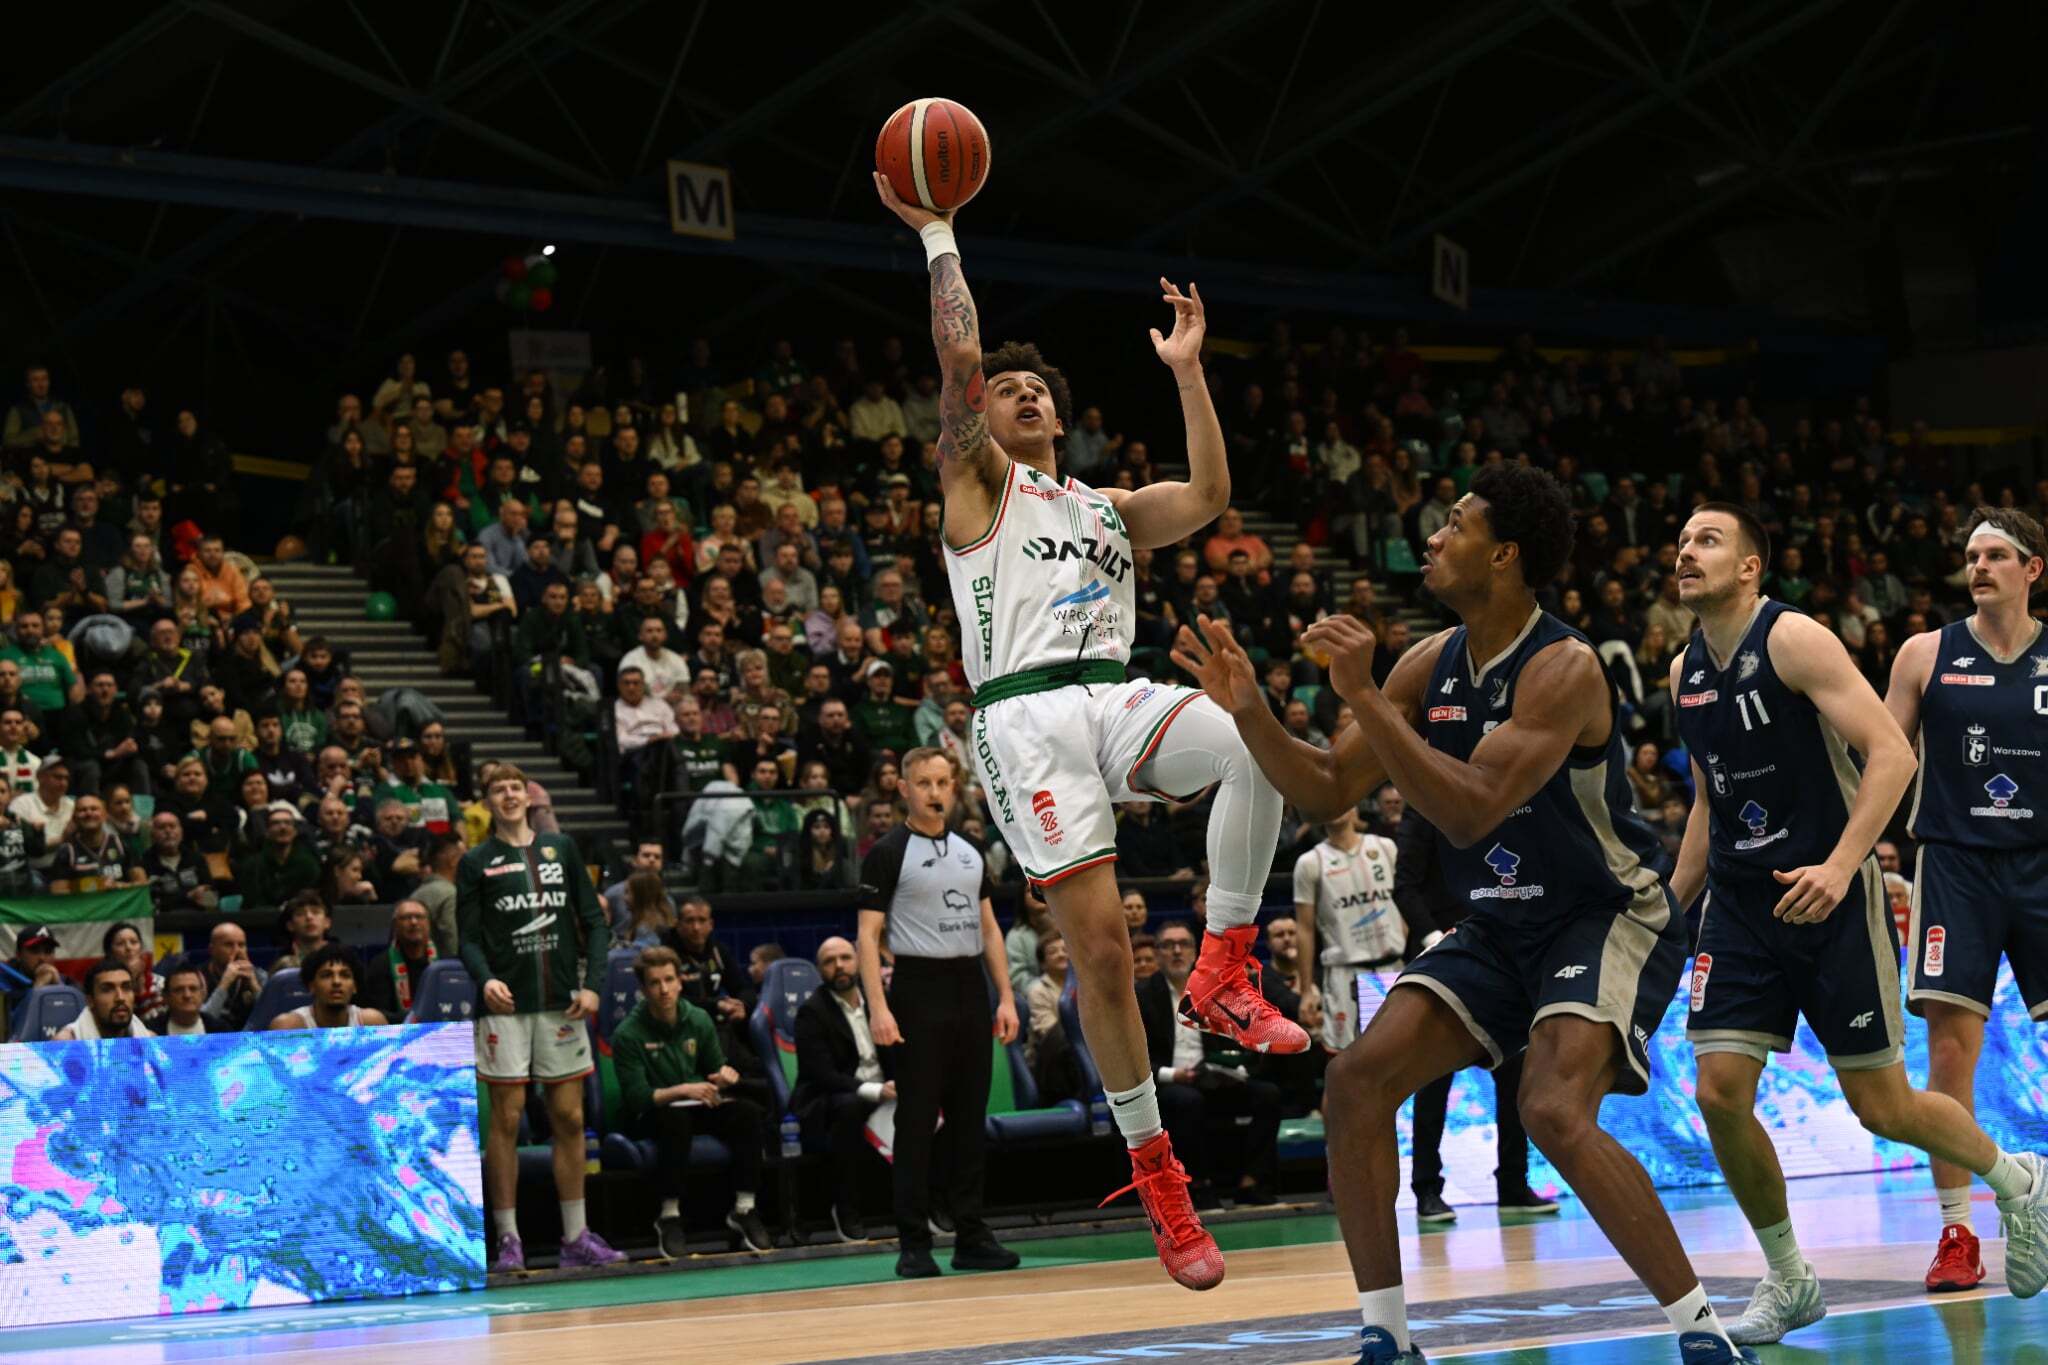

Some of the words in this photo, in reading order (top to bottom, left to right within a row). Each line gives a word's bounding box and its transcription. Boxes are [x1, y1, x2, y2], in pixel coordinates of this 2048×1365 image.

[937, 130, 950, 184] molten
[677, 173, 726, 227] M
[1440, 249, 1462, 296] N
[1023, 536, 1132, 584] BAZALT
[1053, 609, 1118, 625] WROCAW
[1952, 656, 1976, 668] 4F
[1688, 670, 1705, 685] 4F
[1736, 690, 1771, 731] 11
[1992, 746, 2041, 757] Warszawa
[1731, 764, 1776, 780] Warszawa
[537, 863, 564, 884] 22
[494, 892, 568, 911] BAZALT
[1470, 885, 1544, 900] zondacrypto
[1849, 1011, 1874, 1029] 4F
